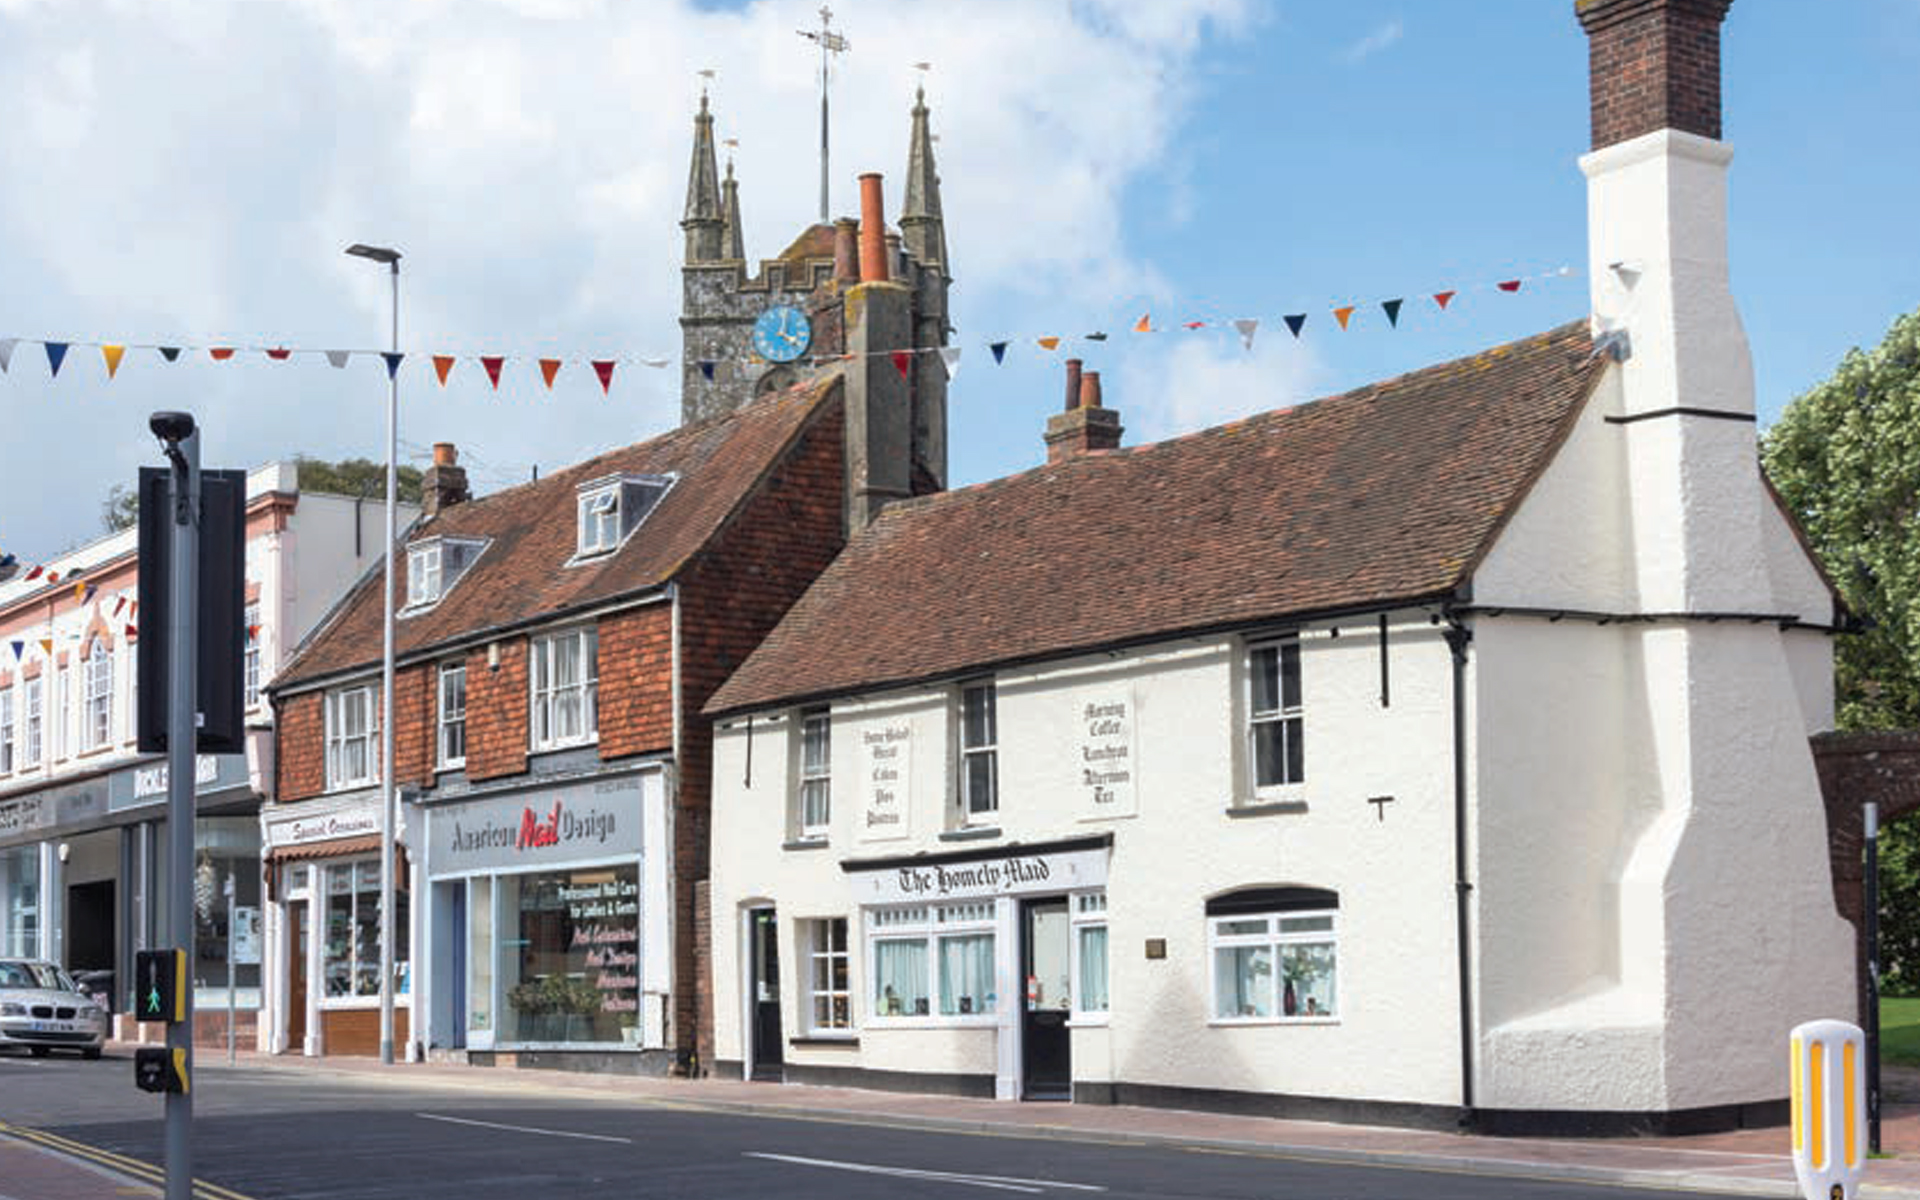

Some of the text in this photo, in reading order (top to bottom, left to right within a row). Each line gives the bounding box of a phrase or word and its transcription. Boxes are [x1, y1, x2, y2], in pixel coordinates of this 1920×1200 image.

[452, 800, 616, 851] American Nail Design
[900, 857, 1050, 894] The Homely Maid
